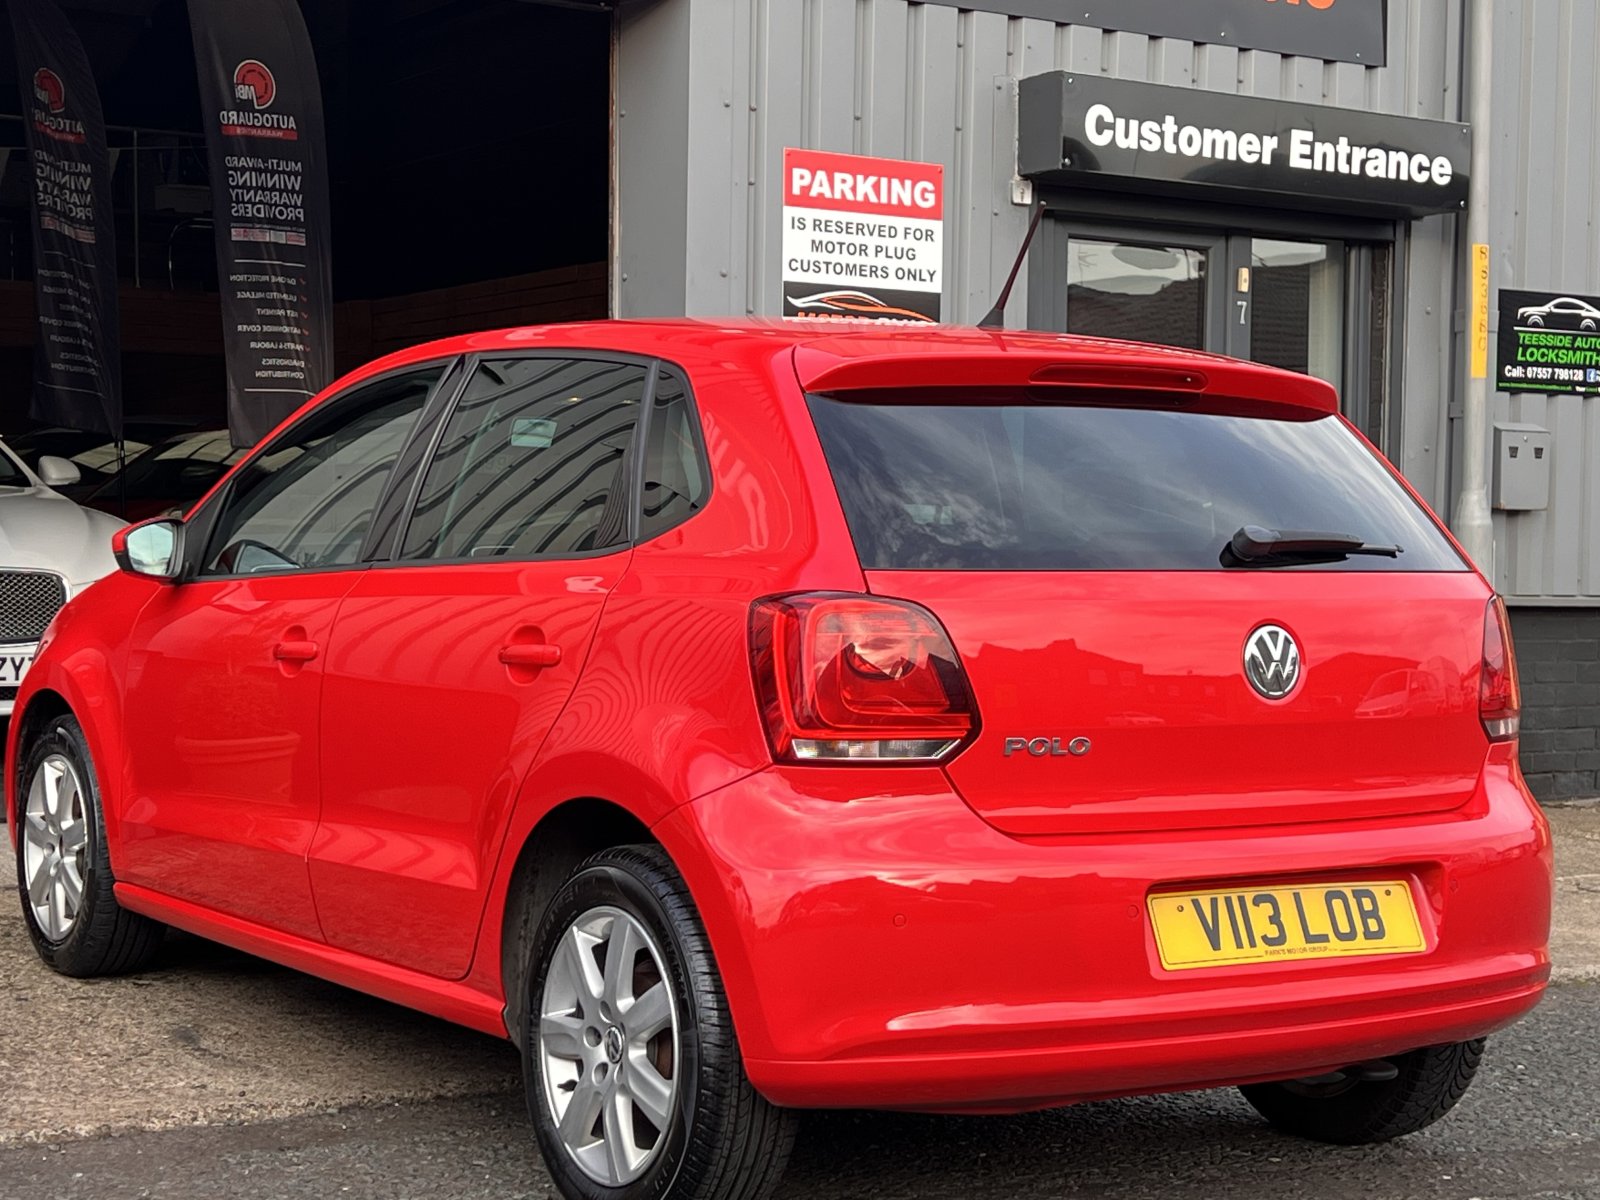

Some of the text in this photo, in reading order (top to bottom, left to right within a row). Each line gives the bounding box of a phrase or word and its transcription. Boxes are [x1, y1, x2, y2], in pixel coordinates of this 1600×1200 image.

[1084, 103, 1453, 186] Customer Entrance
[791, 167, 936, 209] PARKING
[791, 216, 935, 242] IS RESERVED FOR
[811, 239, 916, 261] MOTOR PLUG
[788, 258, 937, 283] CUSTOMERS ONLY
[1236, 300, 1248, 325] 7
[1518, 332, 1573, 347] TEESSIDE
[1517, 347, 1600, 366] LOCKSMITH
[1504, 365, 1526, 378] Call:
[1526, 366, 1552, 380] 07557
[0, 656, 33, 682] ZY
[1003, 736, 1091, 757] POLO
[1191, 888, 1386, 951] V113 LOB
